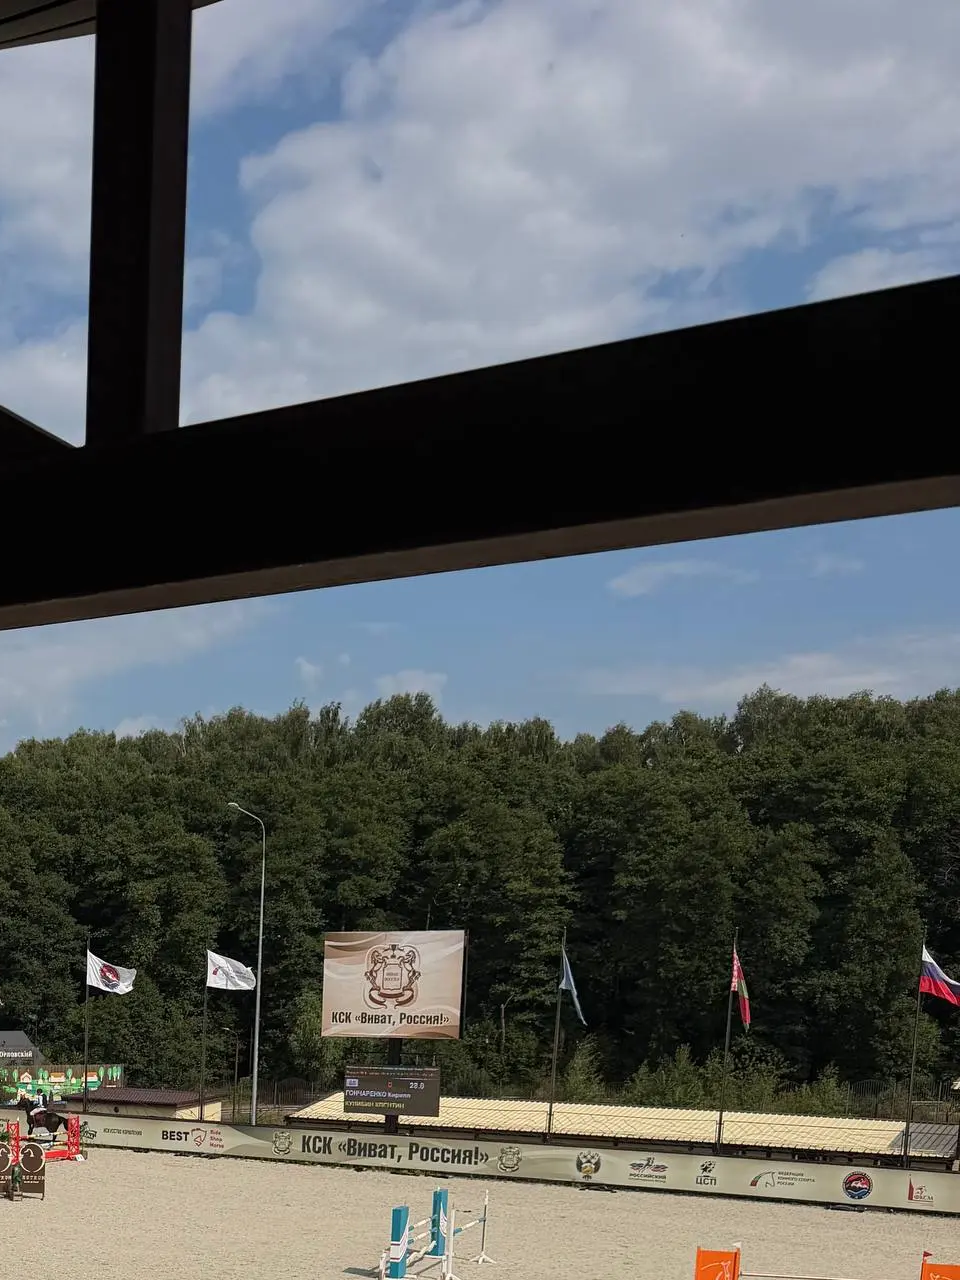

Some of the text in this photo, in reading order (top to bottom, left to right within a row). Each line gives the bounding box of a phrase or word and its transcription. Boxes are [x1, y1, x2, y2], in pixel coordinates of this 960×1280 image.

[331, 1011, 450, 1026] КСК «Виват, Россия!»
[161, 1130, 190, 1142] BEST
[301, 1134, 489, 1166] КСК «Виват, Россия!»
[695, 1177, 717, 1186] ЦСП
